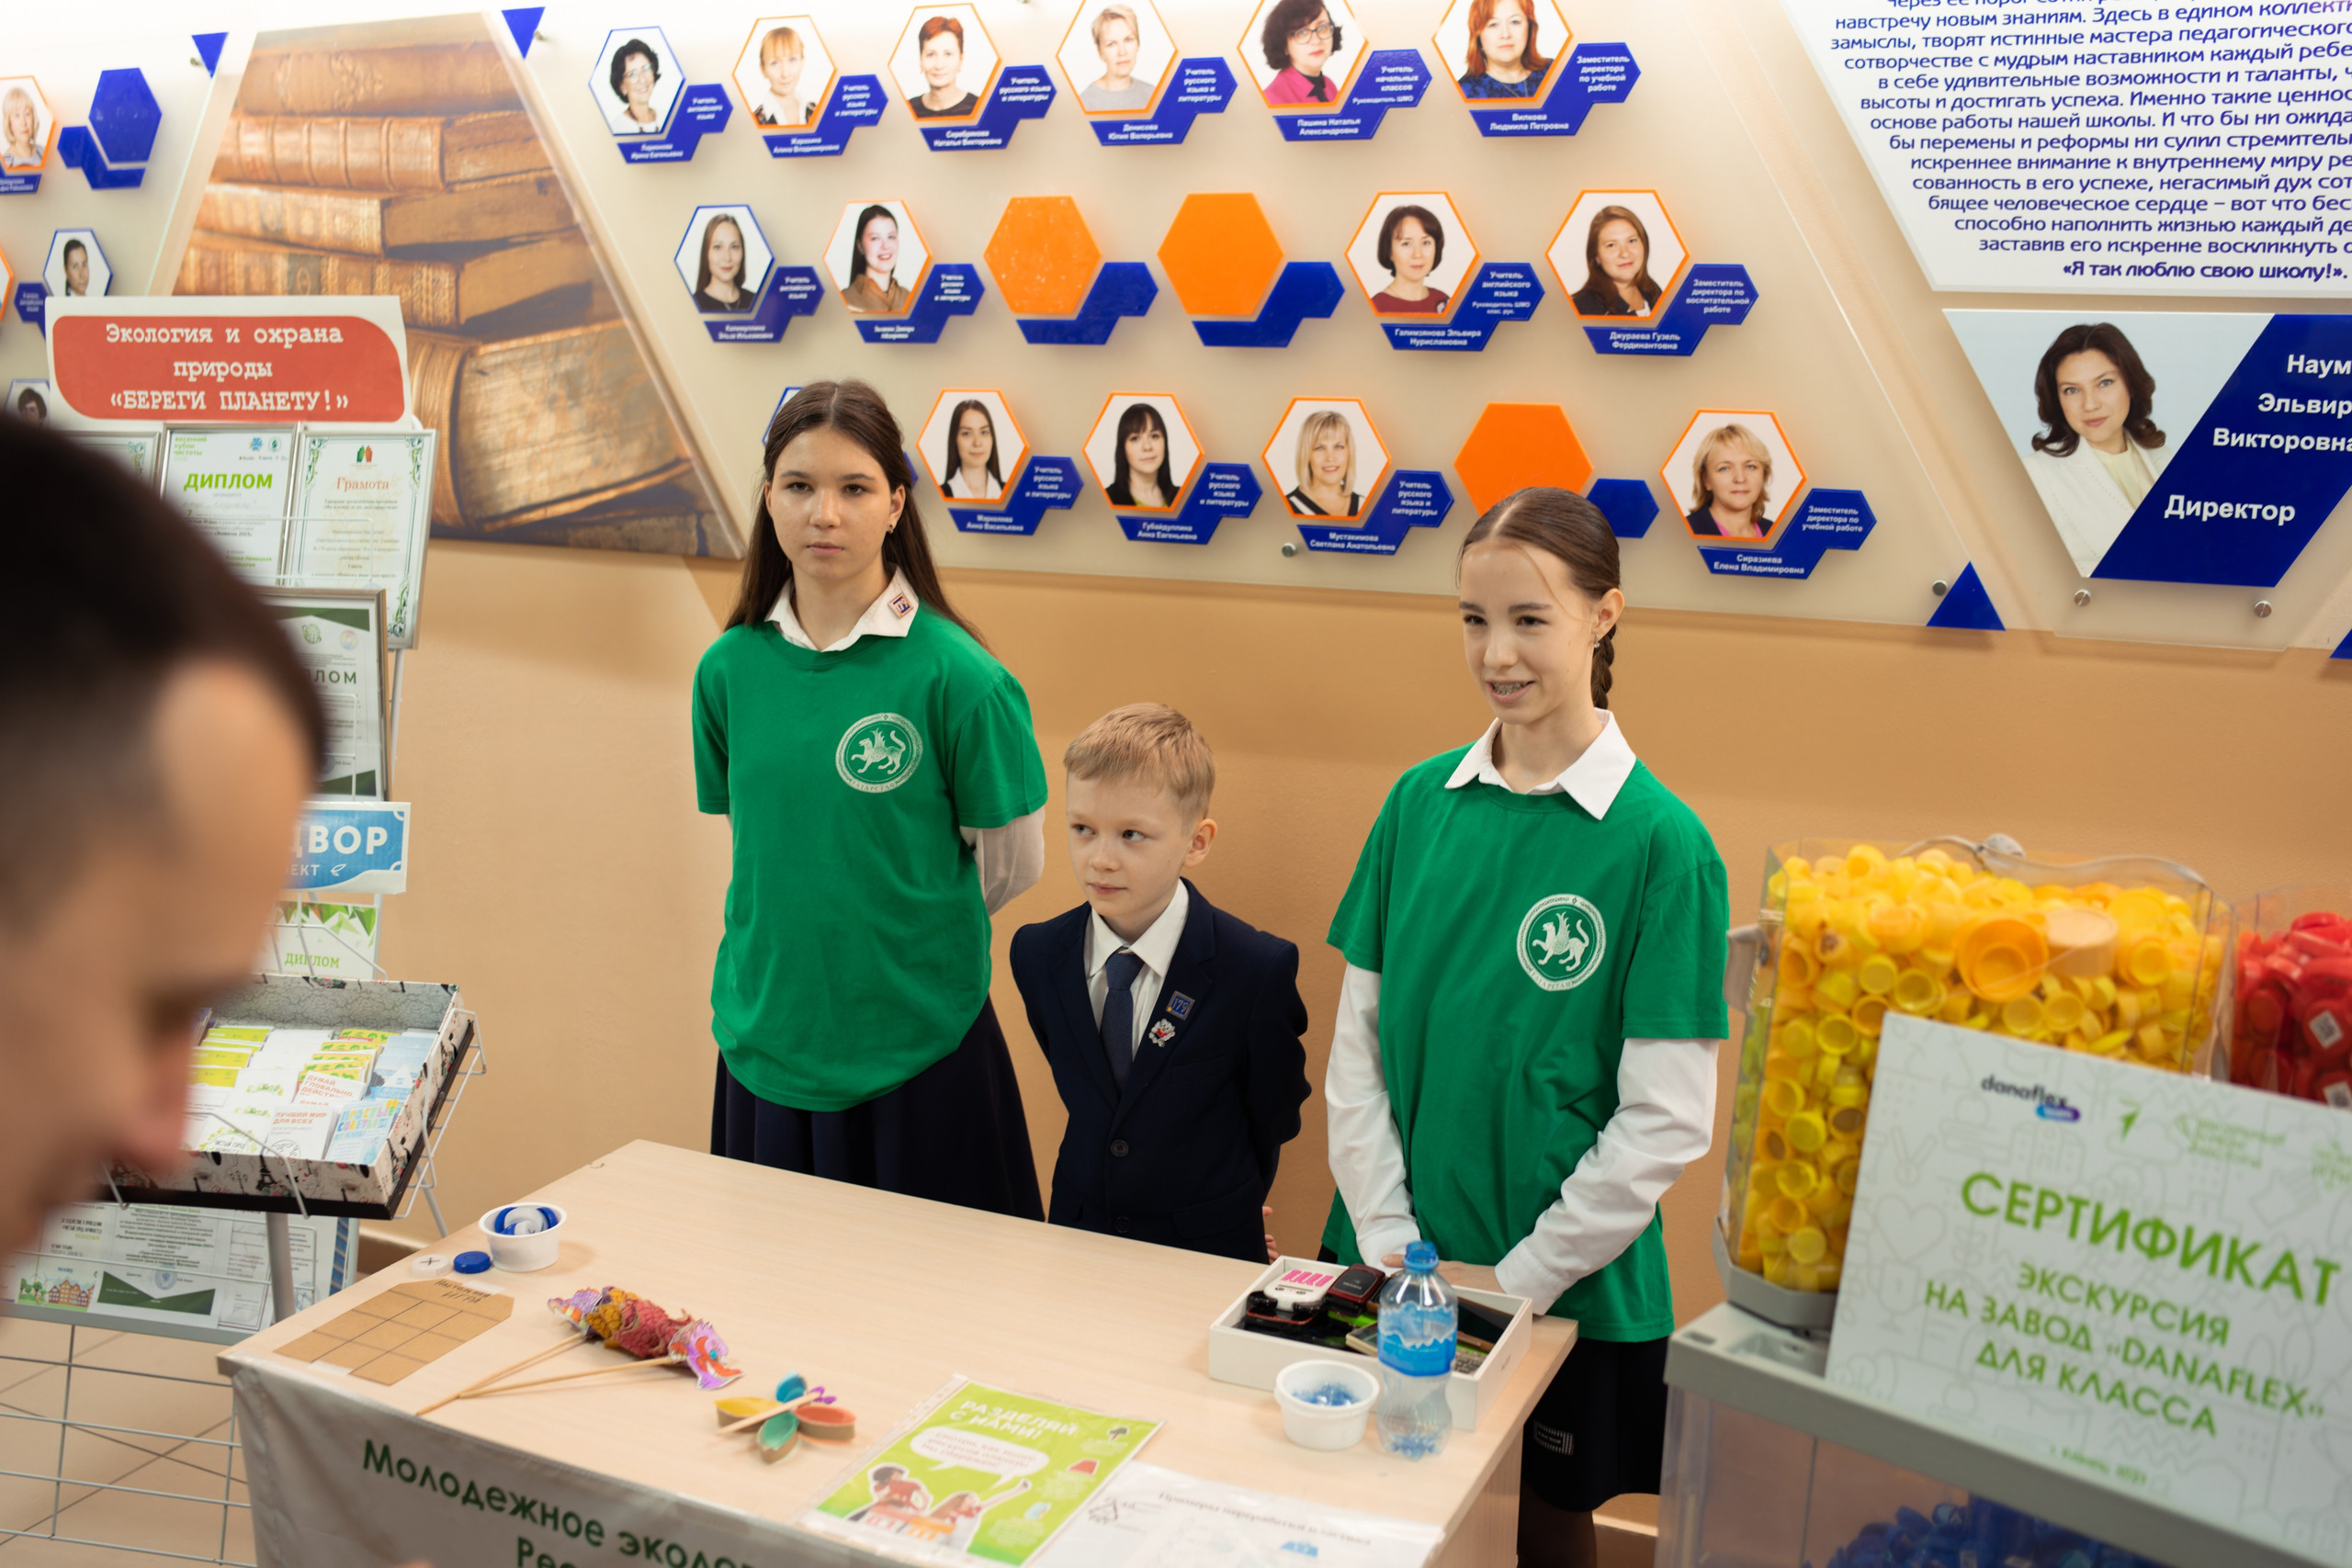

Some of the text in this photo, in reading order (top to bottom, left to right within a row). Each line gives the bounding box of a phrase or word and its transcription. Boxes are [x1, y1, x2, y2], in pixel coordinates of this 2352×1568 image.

[1836, 16, 1931, 32] навстречу
[1936, 14, 1997, 27] новым
[2002, 11, 2086, 26] знаниям.
[2092, 7, 2153, 26] Здесь
[2157, 8, 2169, 21] в
[2175, 5, 2254, 23] едином
[1830, 37, 1917, 51] замыслы,
[1921, 35, 1986, 51] творят
[1990, 32, 2085, 47] истинные
[2089, 29, 2173, 46] мастера
[1576, 55, 1631, 64] Заместитель
[1844, 56, 1973, 73] сотворчестве
[1978, 55, 1989, 67] с
[1994, 53, 2068, 71] мудрым
[2074, 50, 2205, 65] наставником
[2210, 42, 2293, 64] каждый
[1578, 73, 1626, 84] по учебной
[1580, 65, 1625, 74] директора
[1878, 78, 1889, 89] в
[1894, 73, 1939, 89] себе
[1943, 74, 2081, 92] удивительные
[2086, 71, 2222, 86] возможности
[2226, 71, 2239, 83] и
[2245, 67, 2338, 83] таланты,
[1587, 83, 1617, 94] работе
[1860, 97, 1930, 109] высоты
[1935, 97, 1947, 109] и
[1950, 96, 2046, 112] достигать
[2051, 95, 2124, 111] успеха.
[2130, 91, 2207, 107] Именно
[2211, 91, 2272, 105] такие
[1489, 120, 1569, 131] Людмила Петровна
[1511, 112, 1548, 121] Вилкова
[1870, 118, 1938, 130] основе
[1941, 113, 2013, 133] работы
[2018, 112, 2081, 129] нашей
[2086, 115, 2156, 128] школы.
[2162, 111, 2176, 127] И
[2180, 114, 2215, 127] что
[2220, 109, 2249, 126] бы
[2255, 112, 2280, 126] ни
[1889, 134, 1916, 150] бы
[1920, 138, 2016, 153] перемены
[2020, 137, 2032, 149] и
[2037, 133, 2130, 152] реформы
[2134, 136, 2159, 149] ни
[2164, 135, 2222, 152] сулил
[1910, 158, 2012, 174] искреннее
[2017, 157, 2111, 170] внимание
[2116, 157, 2128, 170] к
[2132, 156, 2267, 174] внутреннему
[2270, 155, 2324, 172] миру
[1912, 178, 2021, 190] сованность
[2026, 178, 2038, 190] в
[2041, 178, 2075, 190] его
[2078, 178, 2154, 194] успехе,
[2159, 174, 2270, 190] негасимый
[2273, 176, 2312, 194] дух
[1928, 195, 1989, 214] бящее
[1994, 198, 2131, 211] человеческое
[2134, 198, 2209, 215] сердце
[2230, 198, 2267, 211] вот
[2271, 198, 2307, 211] что
[1954, 215, 2047, 231] способно
[2051, 220, 2154, 232] наполнить
[2157, 220, 2236, 232] жизнью
[2241, 216, 2324, 236] каждый
[1978, 239, 2065, 252] заставив
[2070, 240, 2103, 253] его
[2107, 241, 2202, 256] искренне
[2207, 241, 2338, 258] воскликнуть
[2063, 260, 2348, 283] «Я так люблю свою школу!».
[1691, 288, 1745, 297] директора по
[1693, 278, 1745, 288] Заместитель
[1685, 297, 1750, 306] воспитательной
[1703, 305, 1732, 314] работе
[106, 322, 344, 349] Экология и охрана
[1408, 338, 1468, 346] Нурисламовна
[1447, 329, 1482, 338] Эльвира
[1609, 331, 1680, 341] Джураева Гузель
[173, 361, 274, 383] природы
[2287, 354, 2352, 379] Наум
[110, 389, 349, 412] «БЕРЕГИ ПЛАНЕТУ!»
[2257, 392, 2352, 420] Эльвир
[183, 473, 273, 492] ДИПЛОМ
[334, 477, 390, 493] Грамота
[1806, 515, 1848, 524] директора
[1809, 505, 1859, 514] Заместитель
[2164, 494, 2296, 526] Директор
[1802, 523, 1835, 531] учебной
[1309, 539, 1396, 551] Светлана Анатольевна
[1713, 561, 1804, 574] Елена Владимировна
[1736, 554, 1782, 564] Сиразиева
[1980, 1073, 2068, 1109] danaflex
[1961, 1170, 2342, 1307] СЕРТИФИКАТ
[2018, 1262, 2230, 1348] ЭКСКУРСИЯ
[1925, 1279, 2325, 1420] НА ЗАВОД «DANAFLEX»
[1975, 1340, 2217, 1438] ДЛЯ КЛАССА
[948, 1409, 1046, 1440] С НАМИ!
[959, 1399, 1079, 1438] РАЗДЕЛЯЙ
[362, 1438, 606, 1548] Молодежное
